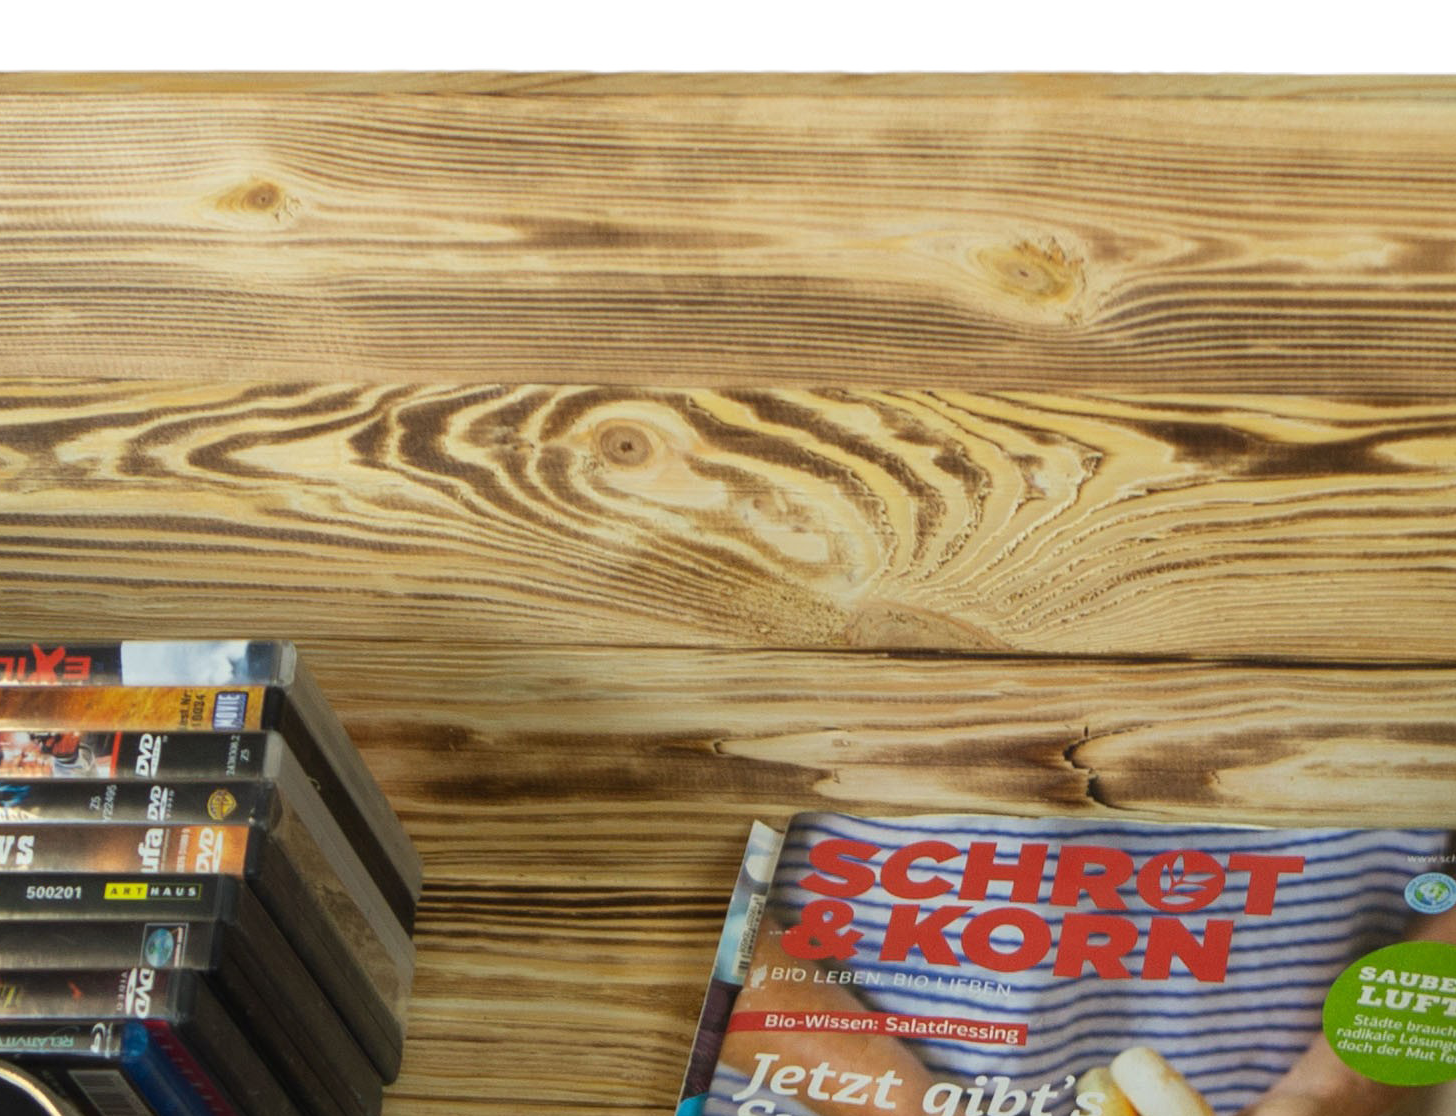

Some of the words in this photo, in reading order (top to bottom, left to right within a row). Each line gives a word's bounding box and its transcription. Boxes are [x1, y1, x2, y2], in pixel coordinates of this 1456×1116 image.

[135, 733, 153, 777] DVD
[147, 785, 162, 821] DVD
[26, 885, 83, 900] 500201
[798, 838, 1305, 915] SCHROT
[780, 899, 866, 960] &
[879, 903, 1234, 983] KORN
[135, 967, 155, 1019] DVD
[770, 967, 806, 982] BIO
[893, 973, 929, 989] BIO
[936, 976, 1012, 997] LIEBEN
[764, 1014, 878, 1031] Bio-Wissen:
[885, 1017, 1020, 1044] Salatdressing
[1336, 1027, 1396, 1043] radikale
[1353, 1013, 1403, 1031] Städte
[1337, 1039, 1373, 1055] doch
[1377, 1042, 1402, 1057] der
[1405, 1047, 1436, 1062] Mut
[732, 1053, 902, 1109] Jetzt
